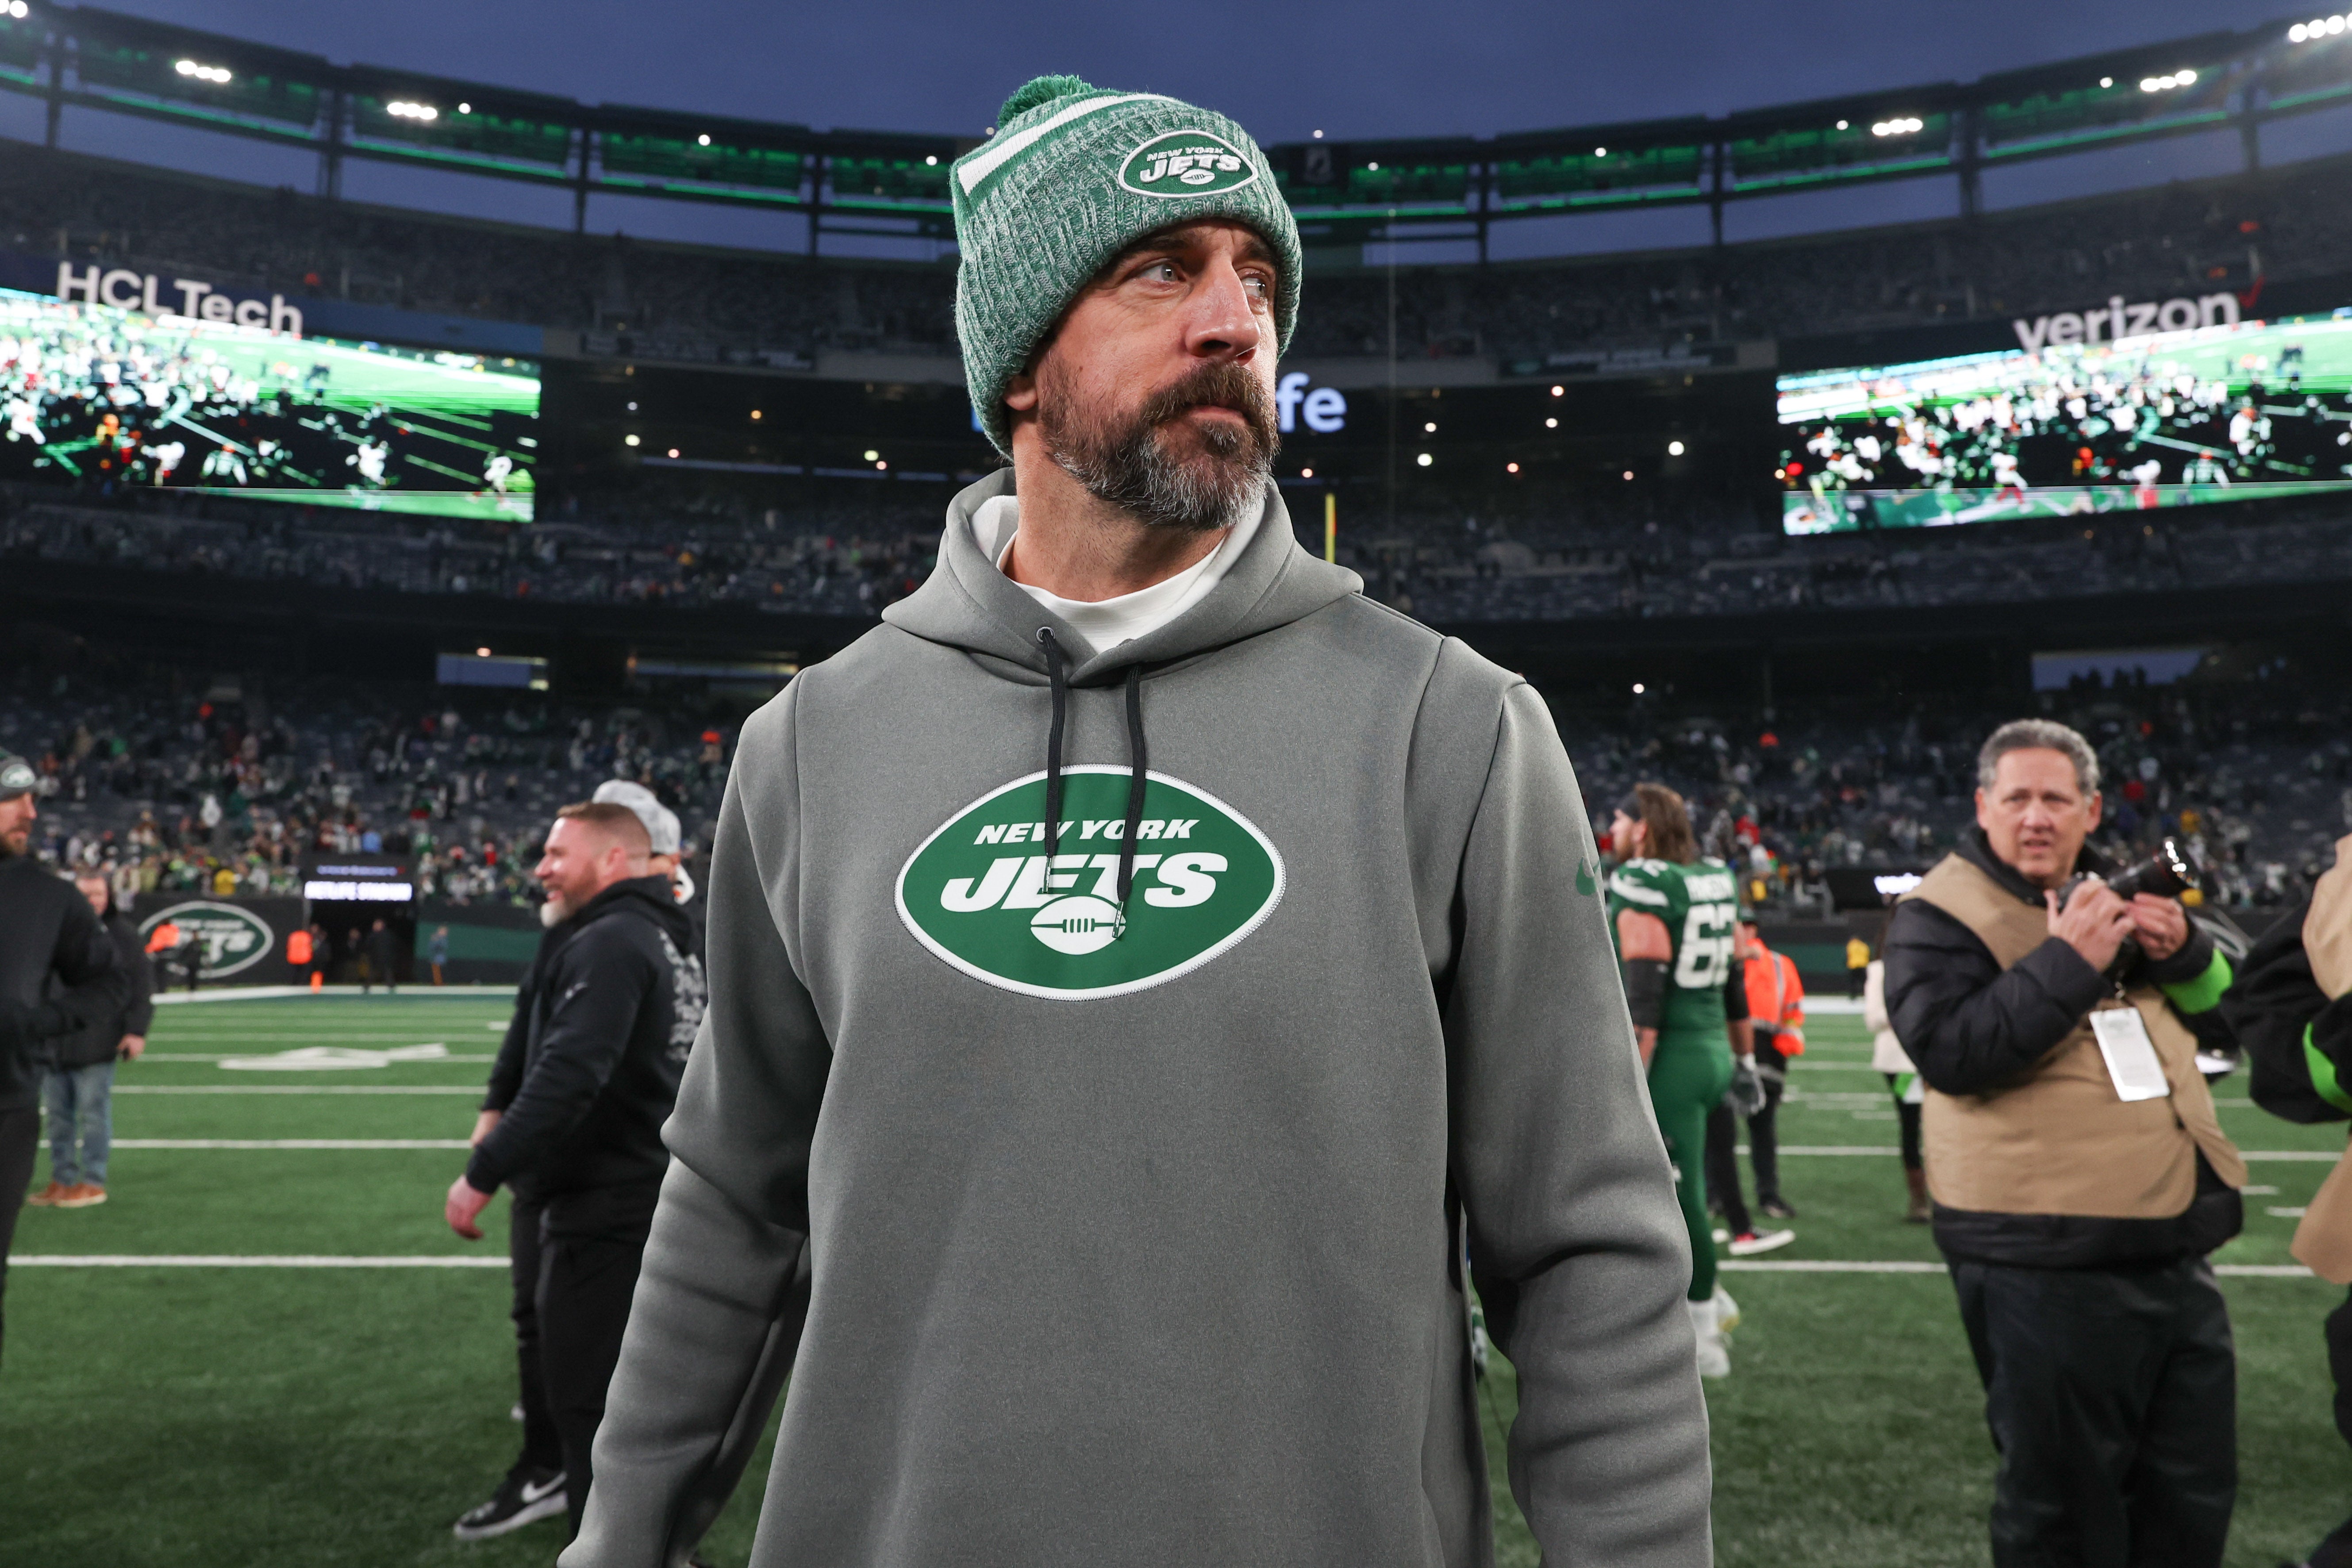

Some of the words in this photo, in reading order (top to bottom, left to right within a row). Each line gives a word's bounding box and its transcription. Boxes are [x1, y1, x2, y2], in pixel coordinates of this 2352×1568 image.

[1140, 154, 1241, 182] JETS
[1146, 149, 1182, 161] NEW
[56, 261, 304, 334] HCLTech
[2012, 292, 2241, 352] verizon
[973, 821, 1075, 845] NEW
[1079, 819, 1200, 840] YORK
[940, 852, 1228, 913] JETS
